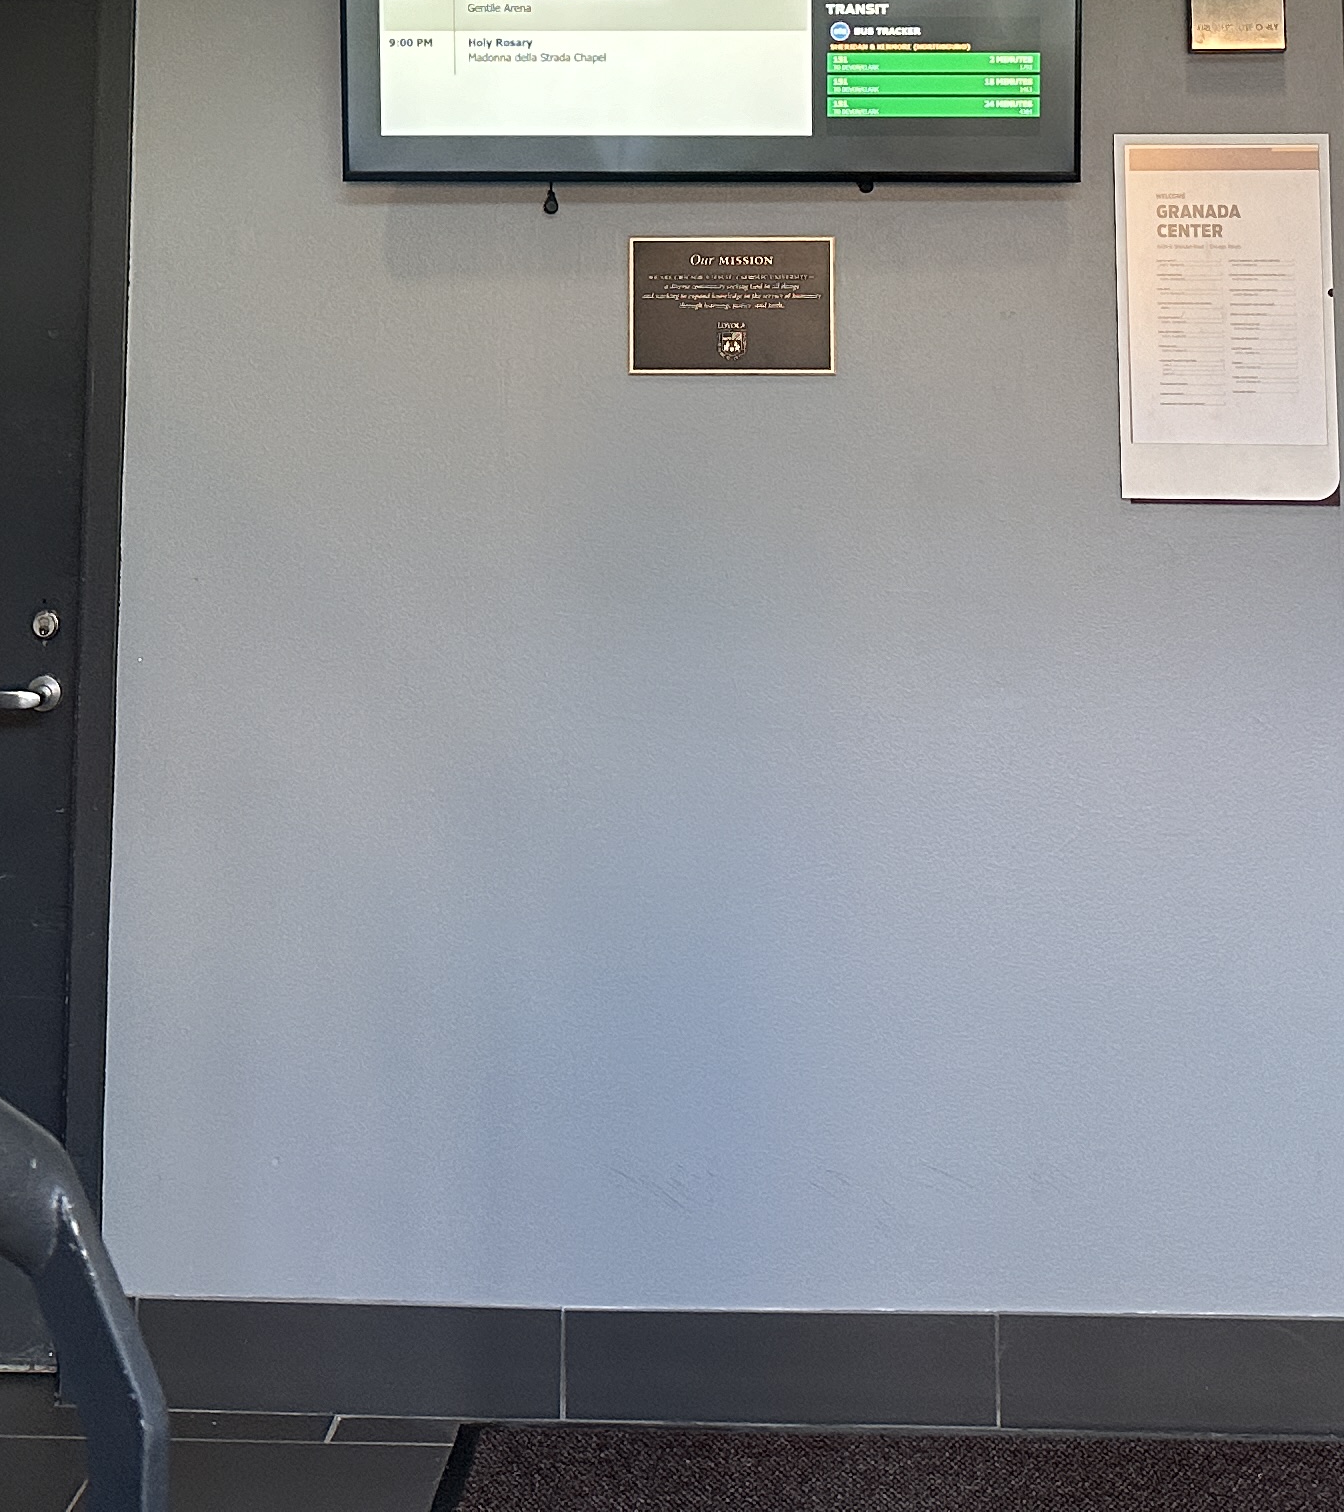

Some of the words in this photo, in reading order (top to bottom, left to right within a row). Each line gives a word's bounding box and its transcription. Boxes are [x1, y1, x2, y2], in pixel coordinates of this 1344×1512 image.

[467, 3, 501, 13] Gentile
[504, 4, 532, 13] Arena
[825, 3, 890, 16] TRANSIT
[853, 26, 875, 36] BUS
[876, 26, 922, 36] TRACKER
[388, 38, 414, 48] 9:00
[416, 38, 433, 47] PM
[468, 37, 493, 49] Holy
[495, 37, 533, 50] Rosary
[468, 53, 512, 63] Madonna
[514, 53, 537, 62] della
[540, 53, 571, 63] Strada
[574, 52, 607, 64] Chapel
[1156, 204, 1242, 219] GRANADA
[1156, 223, 1224, 238] CENTER
[690, 253, 715, 266] Our
[718, 256, 774, 265] MISSION
